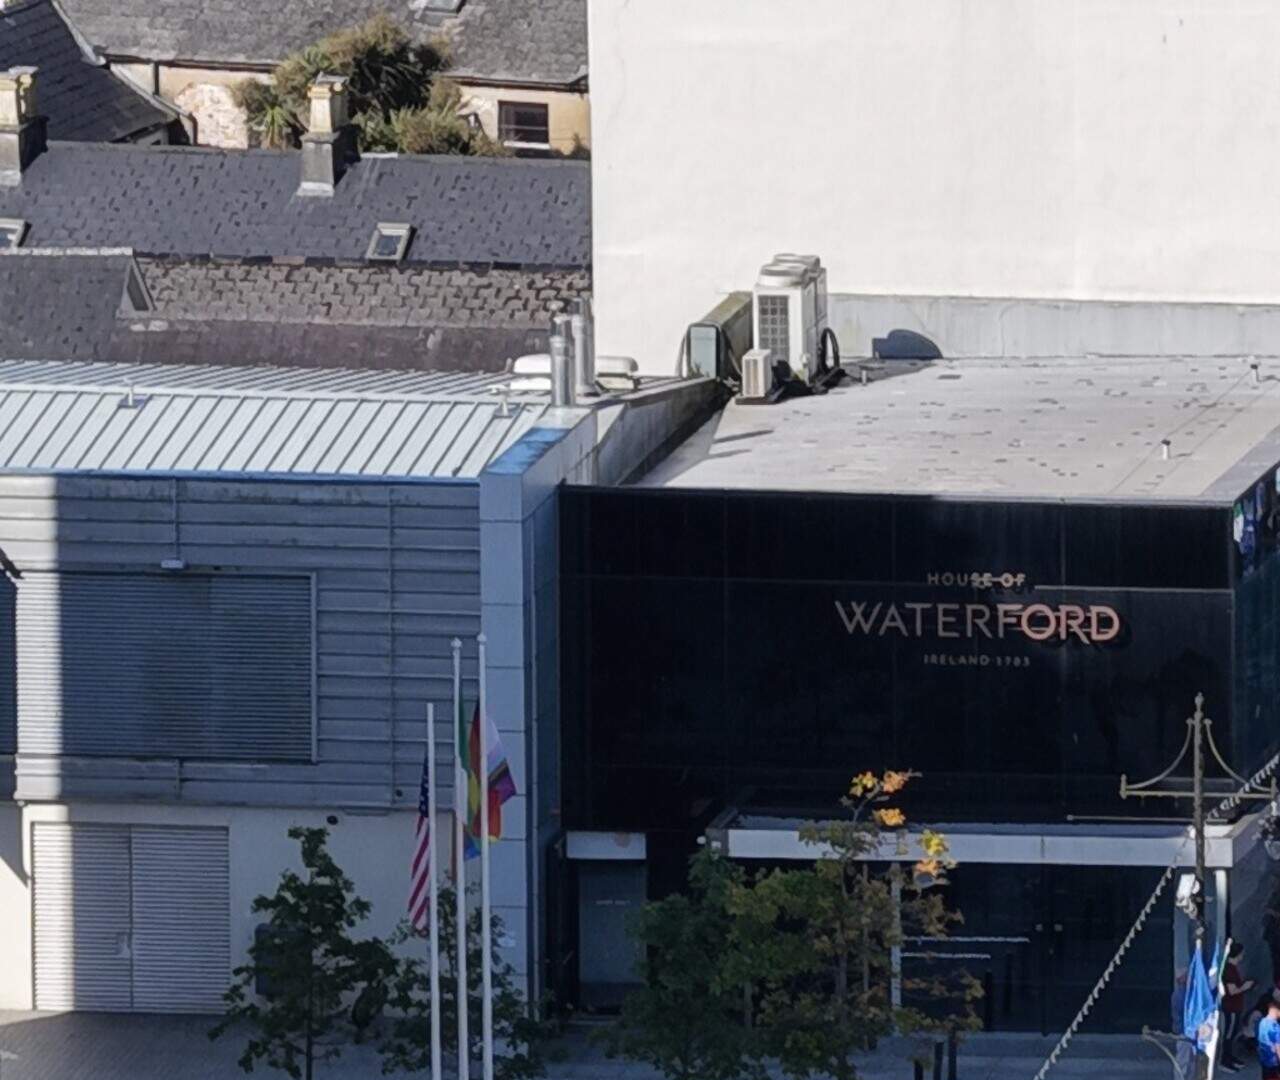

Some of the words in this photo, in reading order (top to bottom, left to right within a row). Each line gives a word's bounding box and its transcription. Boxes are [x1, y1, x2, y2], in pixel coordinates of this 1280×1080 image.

[927, 572, 993, 588] HOUSE
[1001, 573, 1026, 588] OF
[834, 600, 1120, 644] WATERFORD
[923, 654, 990, 666] IRELAND
